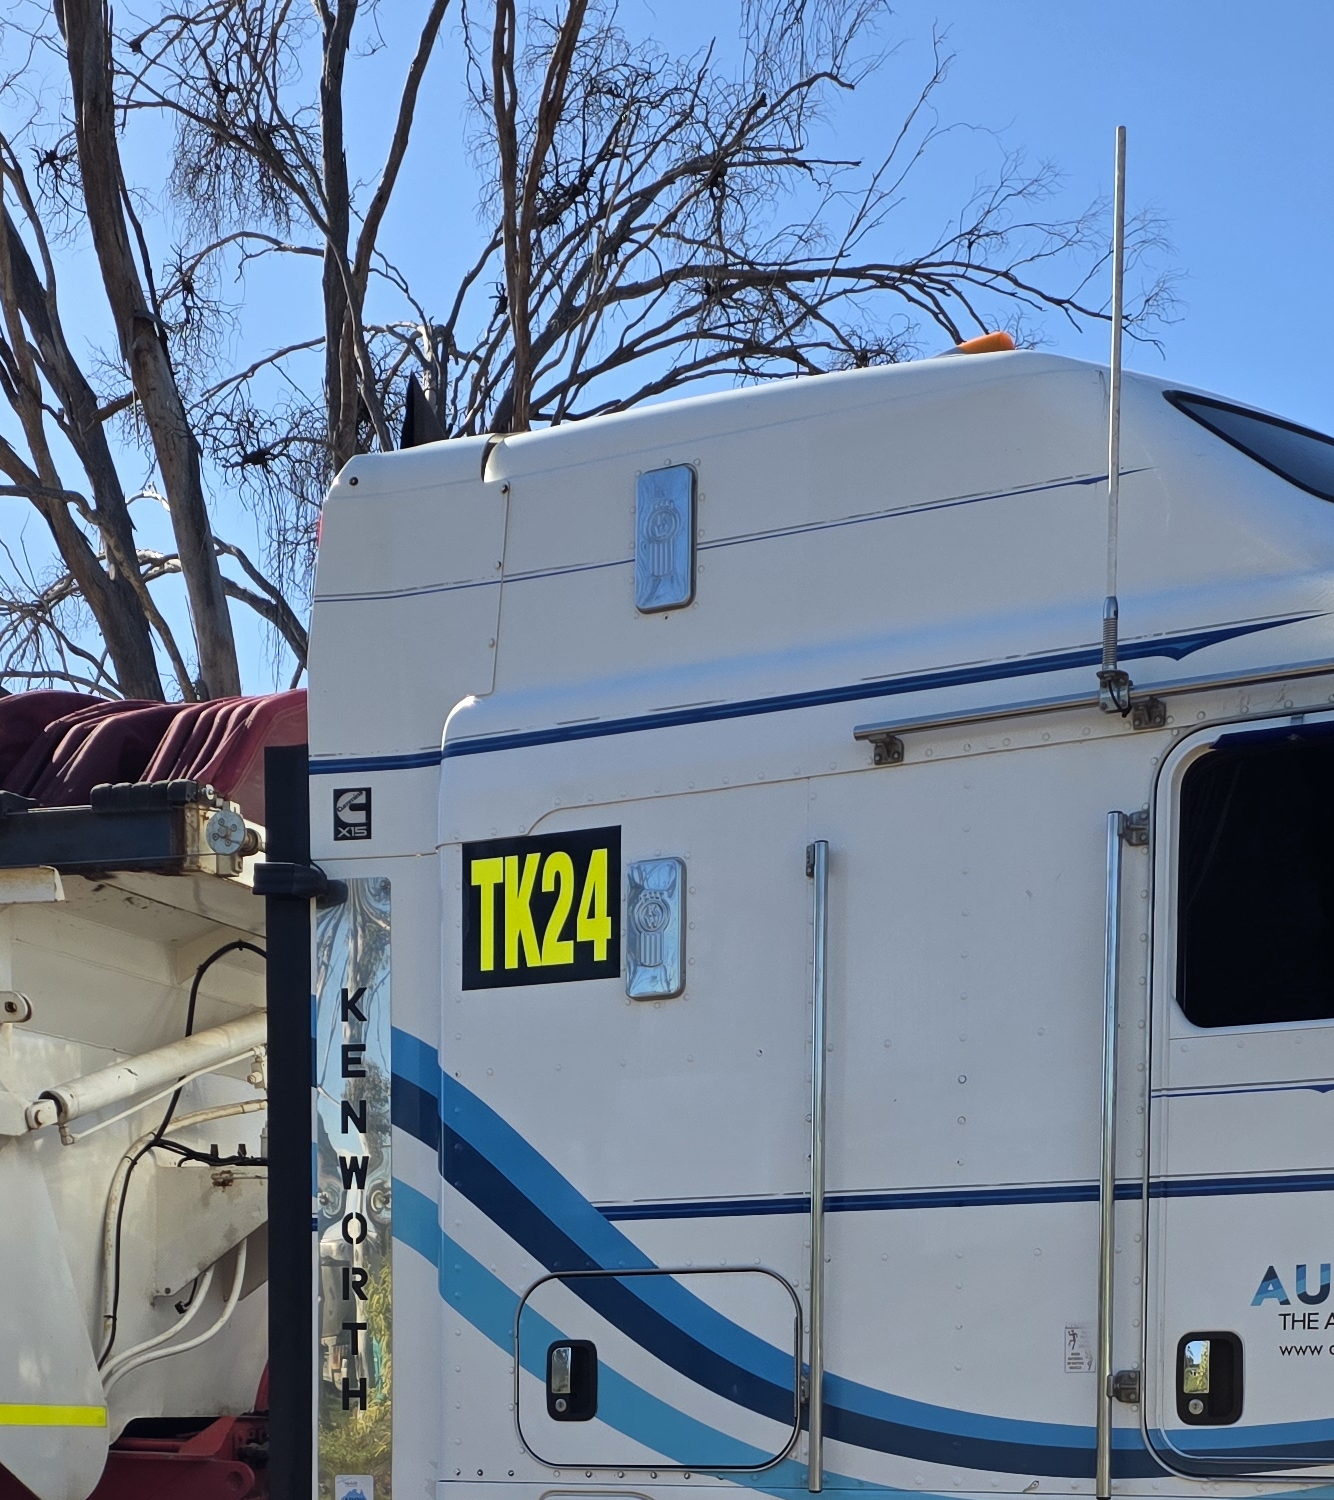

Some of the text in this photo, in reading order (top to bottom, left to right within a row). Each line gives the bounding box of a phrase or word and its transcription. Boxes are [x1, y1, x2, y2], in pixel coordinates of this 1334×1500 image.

[337, 826, 368, 838] X15
[471, 848, 612, 971] TK24
[339, 987, 369, 1410] KENWORTH
[1278, 1312, 1319, 1331] THE
